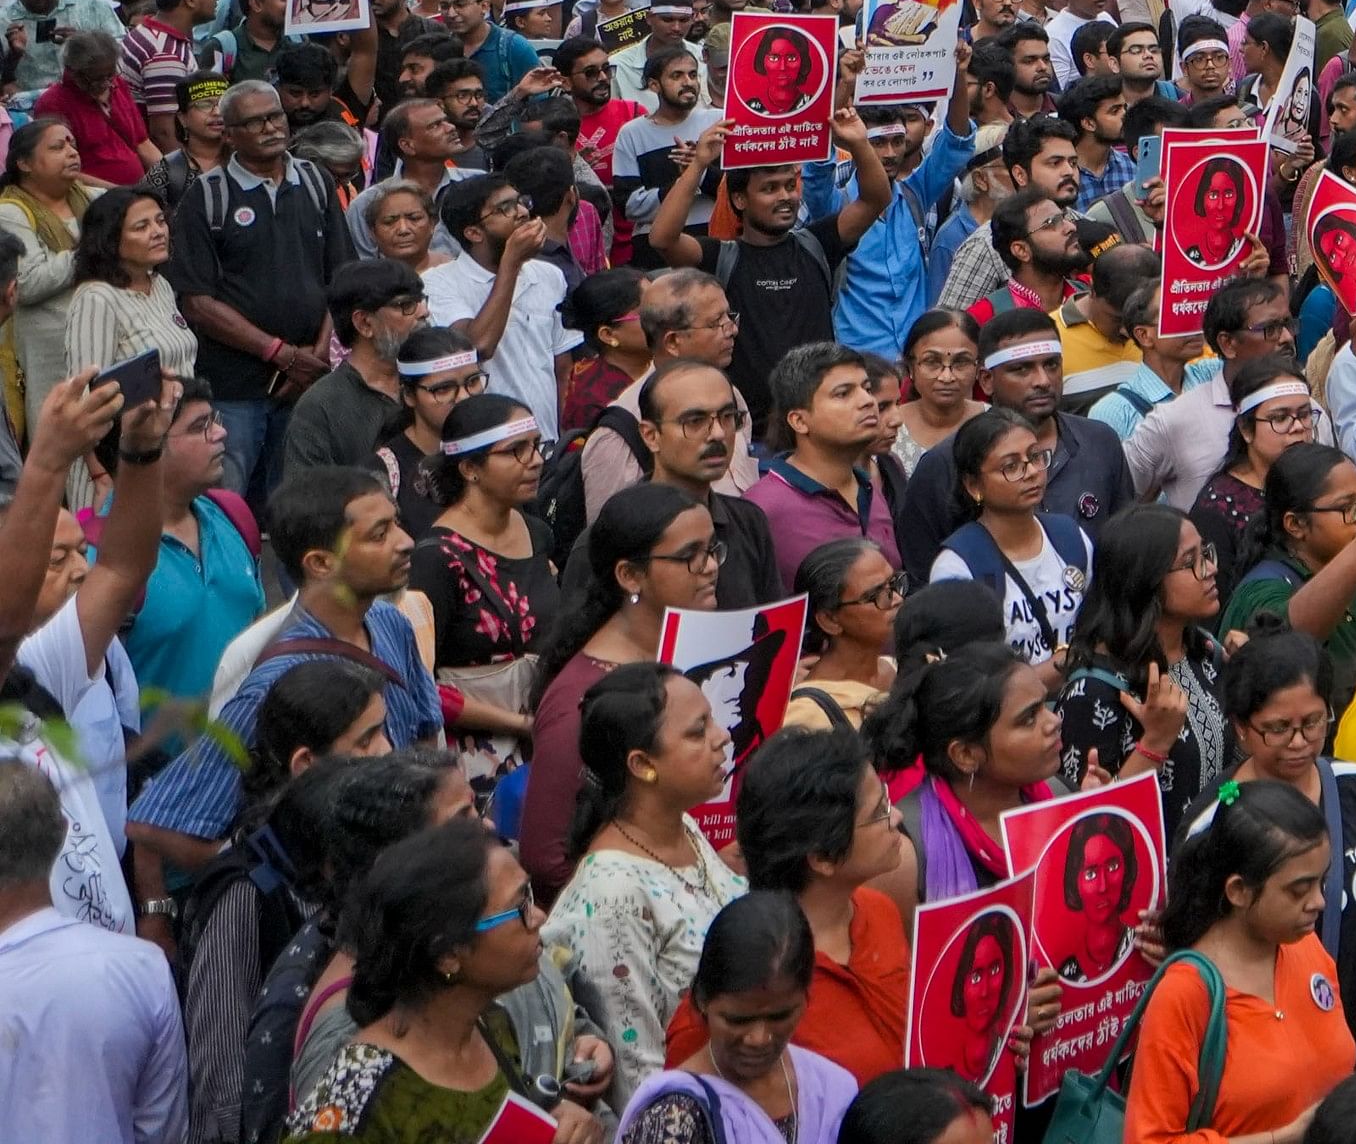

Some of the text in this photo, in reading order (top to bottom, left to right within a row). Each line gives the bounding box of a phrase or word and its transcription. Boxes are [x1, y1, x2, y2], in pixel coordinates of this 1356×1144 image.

[603, 14, 633, 34] অভয়ার
[777, 123, 792, 134] এই
[793, 120, 823, 133] মাটিতে
[734, 139, 776, 153] ধর্ষকদের
[799, 135, 819, 148] নাই
[1170, 279, 1210, 294] প্রীতিলতার
[703, 814, 720, 826] kill
[714, 828, 732, 840] kill
[1097, 990, 1113, 1013] এই
[1042, 1031, 1094, 1067] ধর্ষকদের
